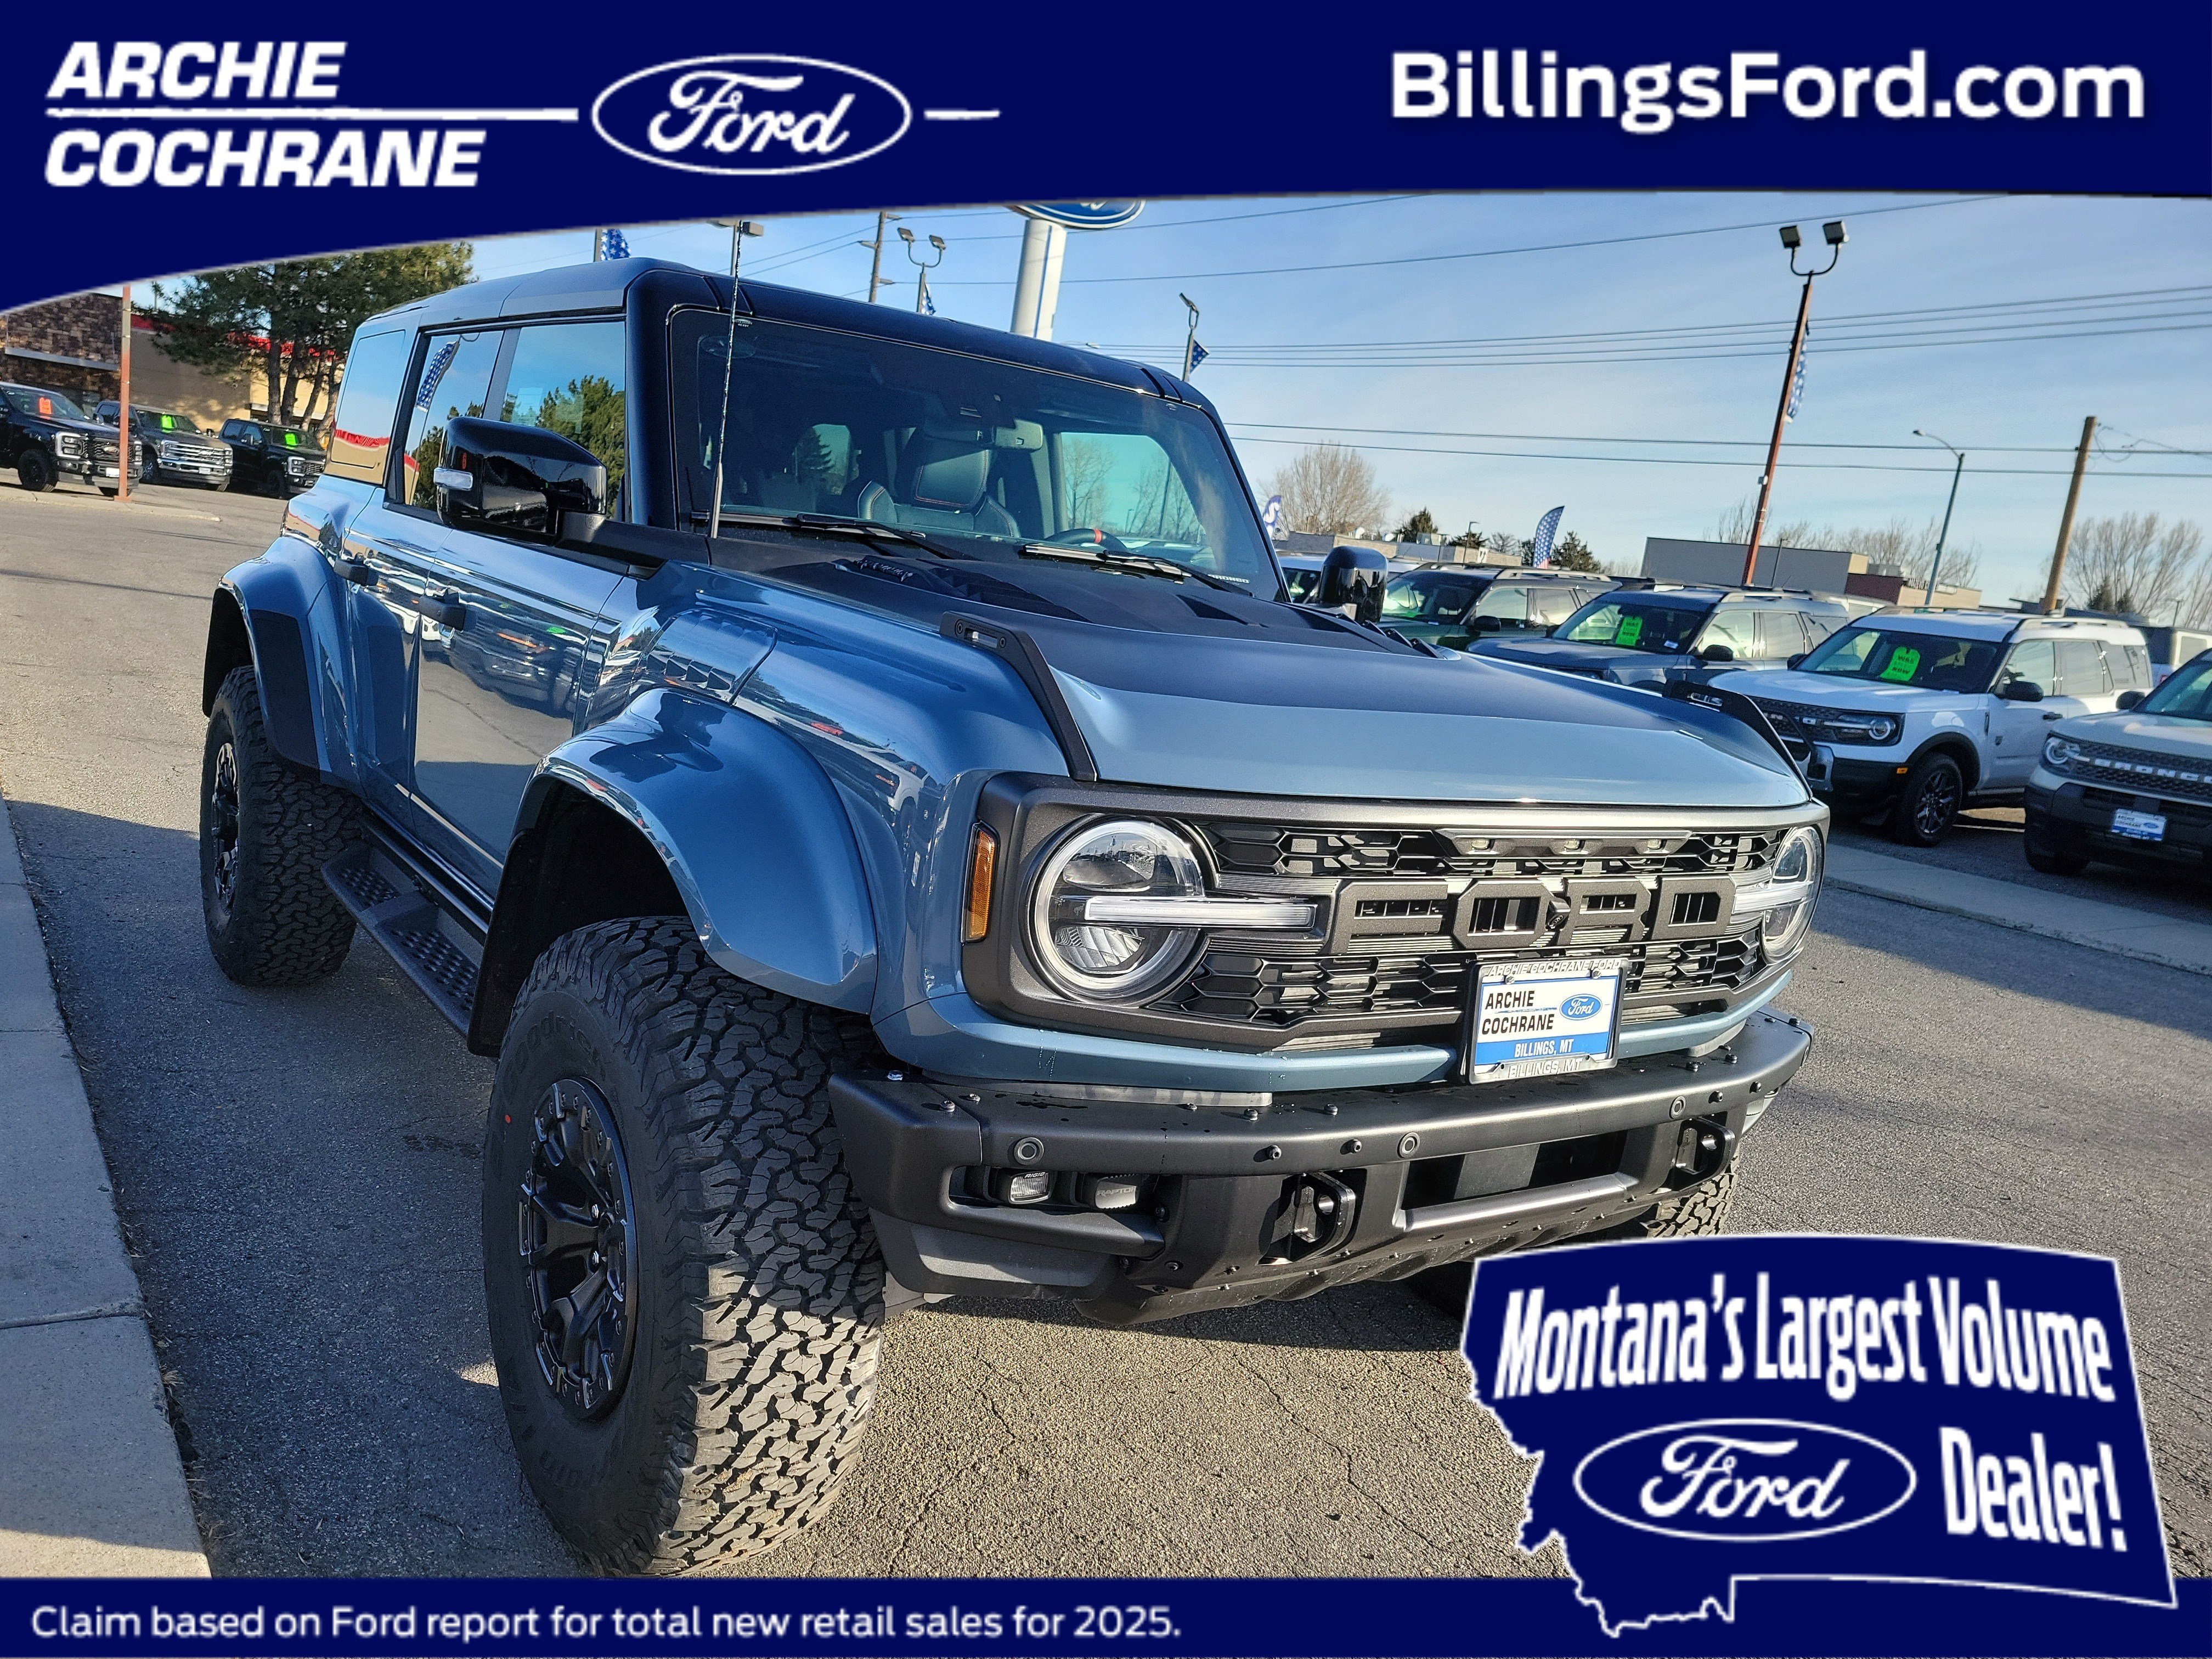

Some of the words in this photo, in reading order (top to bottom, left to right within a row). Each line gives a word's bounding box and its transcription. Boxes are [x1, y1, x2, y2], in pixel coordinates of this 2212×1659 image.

[1331, 880, 1732, 955] FORD
[1488, 964, 1527, 976] ARCHIE
[1530, 961, 1590, 973] COCHRANE
[1591, 959, 1621, 970] FORD
[1485, 990, 1535, 1009] ARCHIE
[1567, 998, 1593, 1015] Ford
[1482, 1014, 1555, 1035] COCHRANE
[1514, 1041, 1557, 1058] BILLINGS,
[1559, 1039, 1574, 1053] MT
[1509, 1061, 1561, 1078] BILLINGS,
[1563, 1058, 1583, 1071] MT
